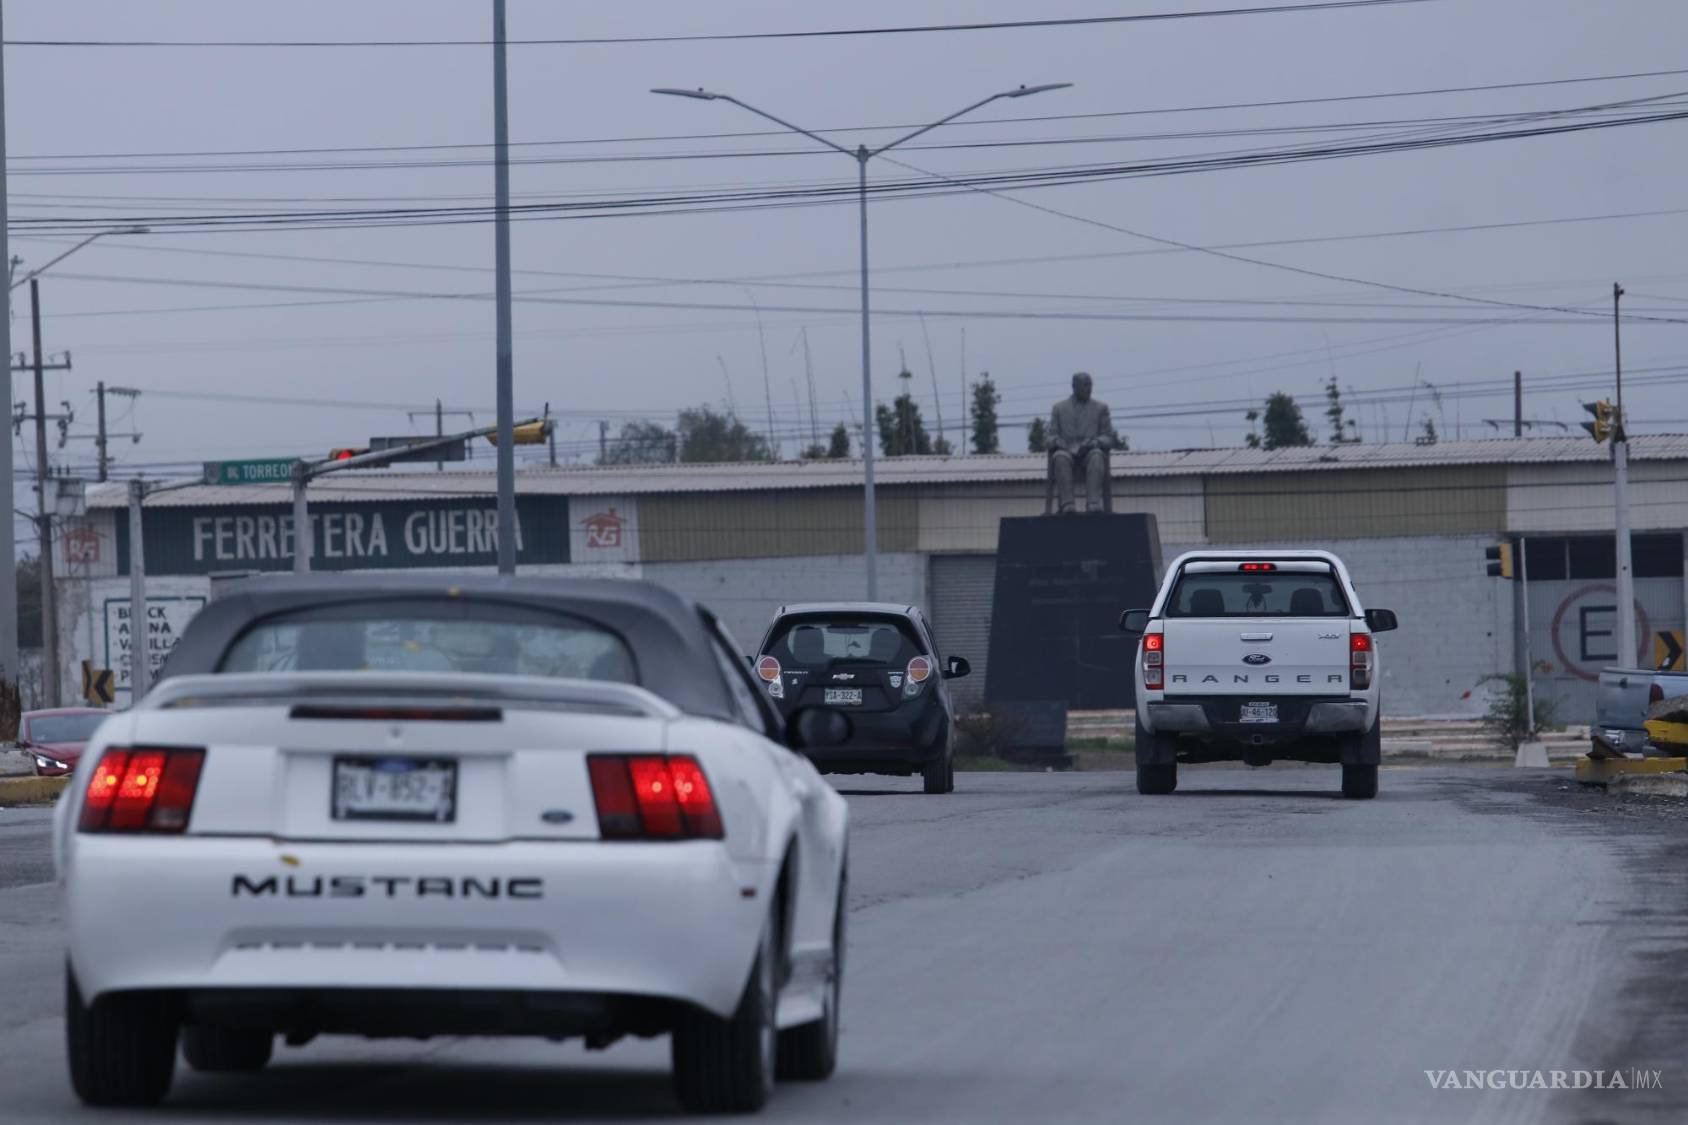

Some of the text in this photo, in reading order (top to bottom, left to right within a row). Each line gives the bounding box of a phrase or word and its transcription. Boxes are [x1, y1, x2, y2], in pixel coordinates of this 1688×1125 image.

[118, 622, 171, 634] ANA
[1580, 606, 1617, 661] E
[1172, 674, 1343, 683] RANGER
